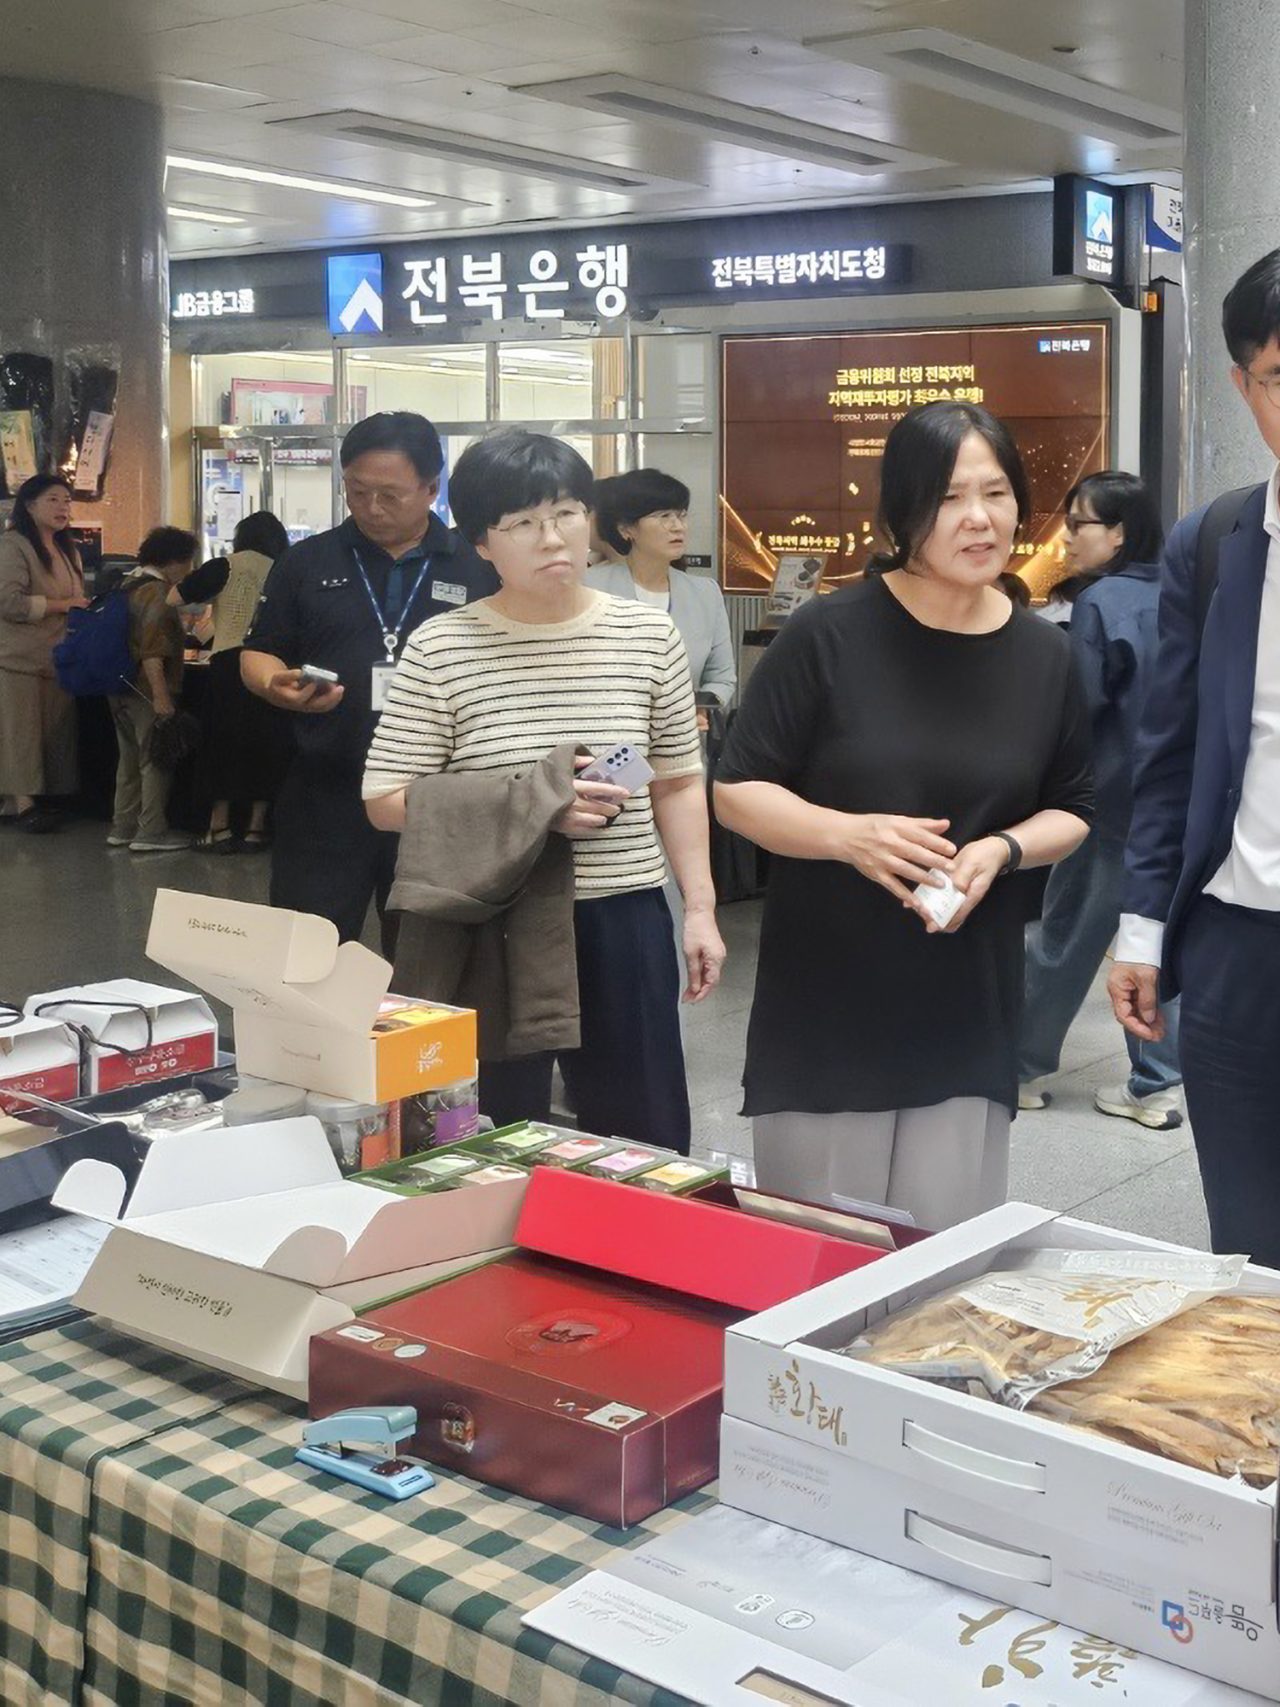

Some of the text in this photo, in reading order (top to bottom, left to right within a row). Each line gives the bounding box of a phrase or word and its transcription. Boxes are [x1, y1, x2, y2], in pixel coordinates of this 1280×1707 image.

[402, 244, 628, 324] 전북은행
[712, 246, 886, 288] 전북특별자치도청
[172, 288, 254, 317] JB금융그룹
